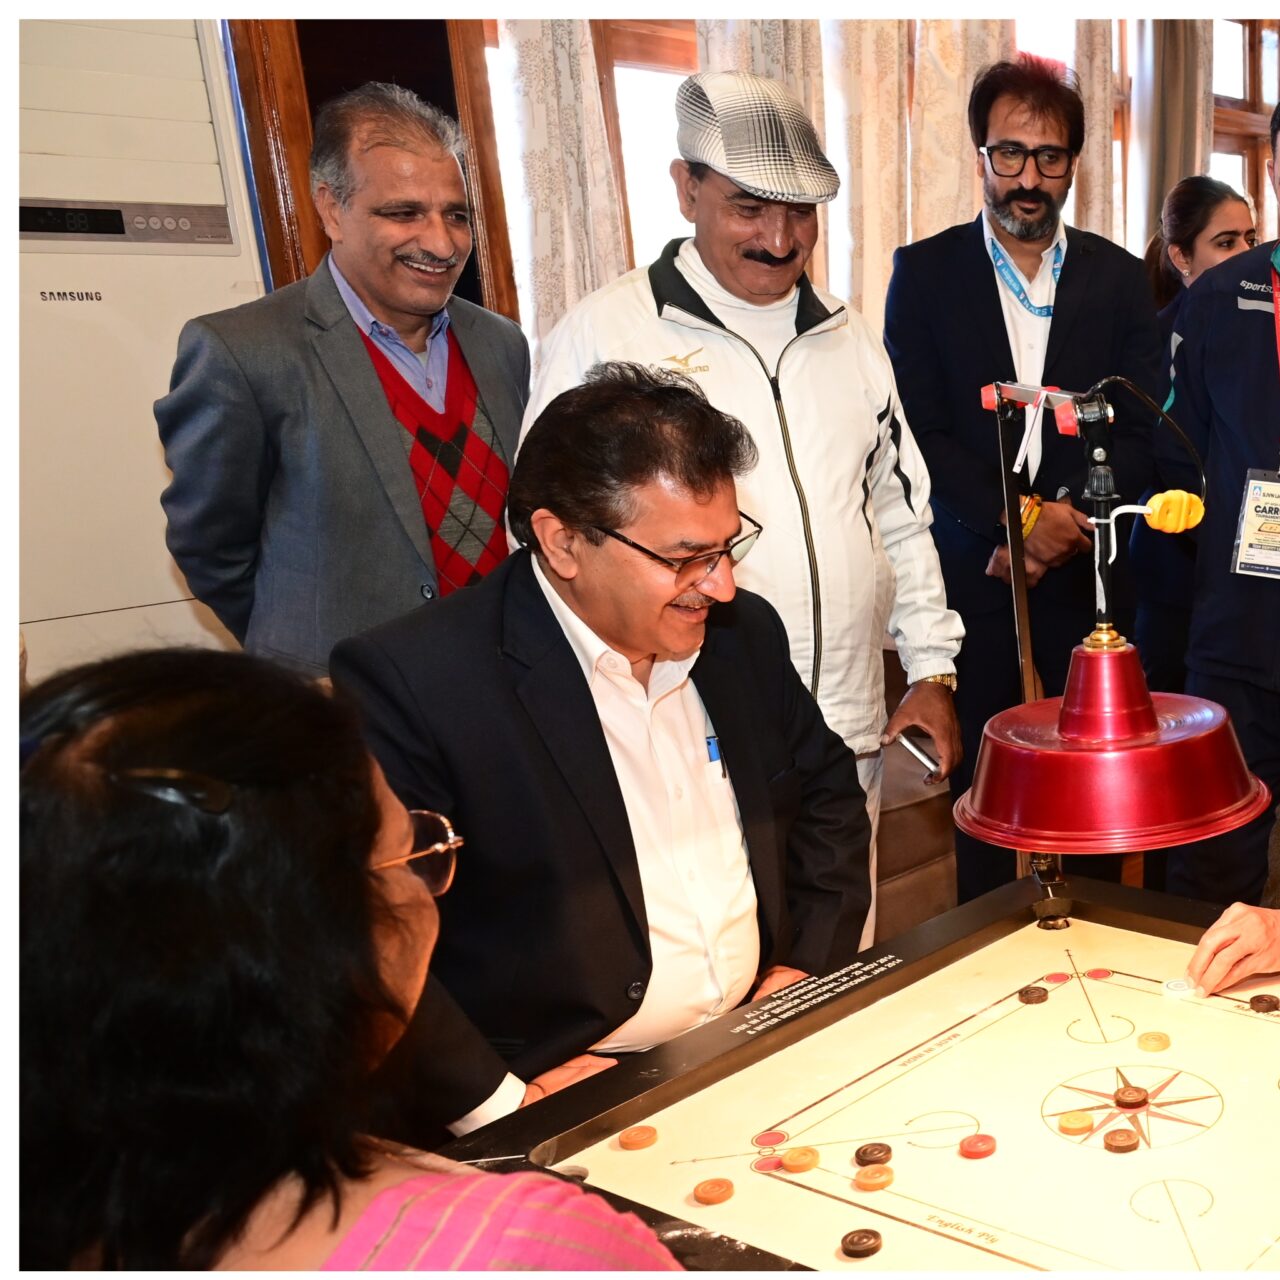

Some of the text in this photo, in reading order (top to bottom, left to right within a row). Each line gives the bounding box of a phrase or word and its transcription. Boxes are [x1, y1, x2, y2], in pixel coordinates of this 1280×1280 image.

[40, 291, 102, 301] SAMSUNG
[771, 978, 811, 999] Approved
[744, 1008, 761, 1019] ALL
[927, 1214, 974, 1235] English
